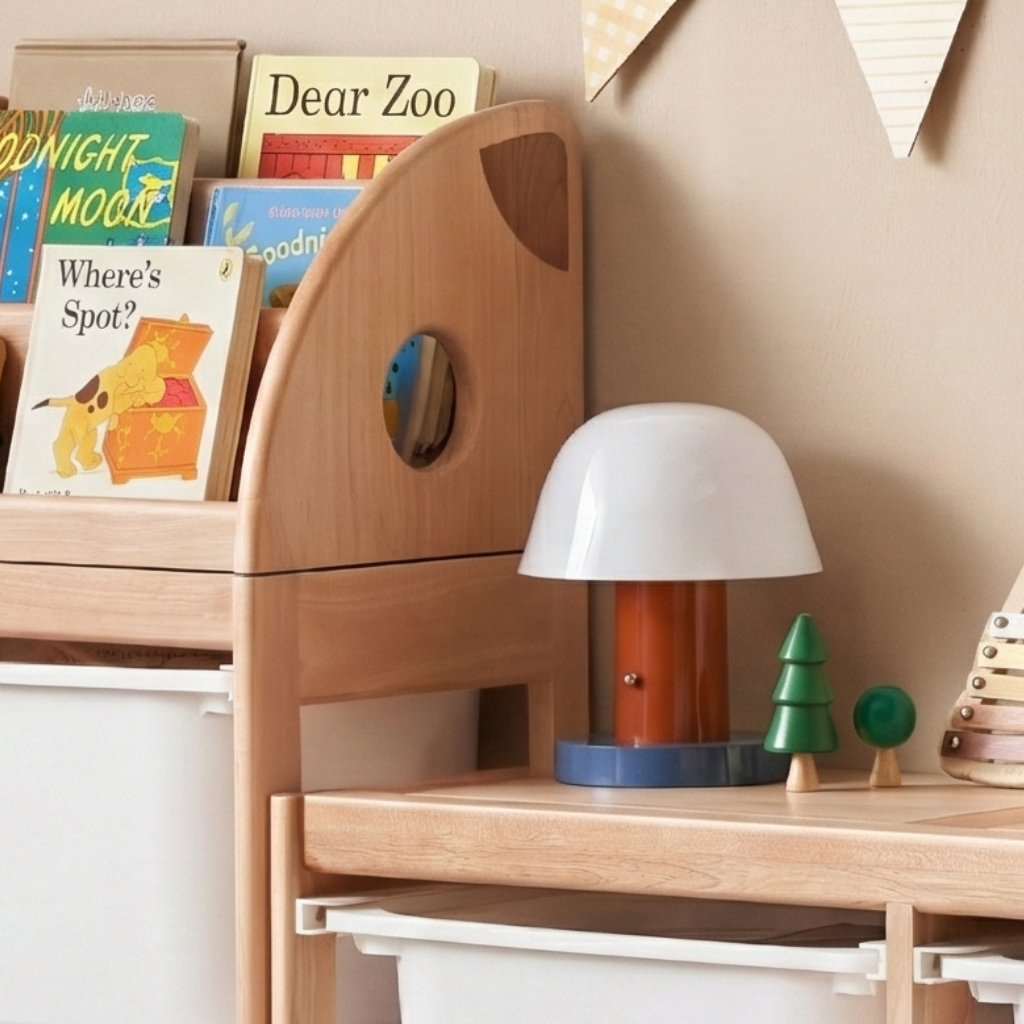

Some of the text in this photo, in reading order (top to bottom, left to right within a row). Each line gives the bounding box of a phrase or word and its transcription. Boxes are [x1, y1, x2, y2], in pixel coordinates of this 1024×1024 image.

[265, 73, 456, 118] Dear Zoo
[50, 187, 153, 228] MOON
[246, 226, 327, 265] oodni
[58, 259, 161, 289] Where's
[61, 299, 137, 336] Spot?
